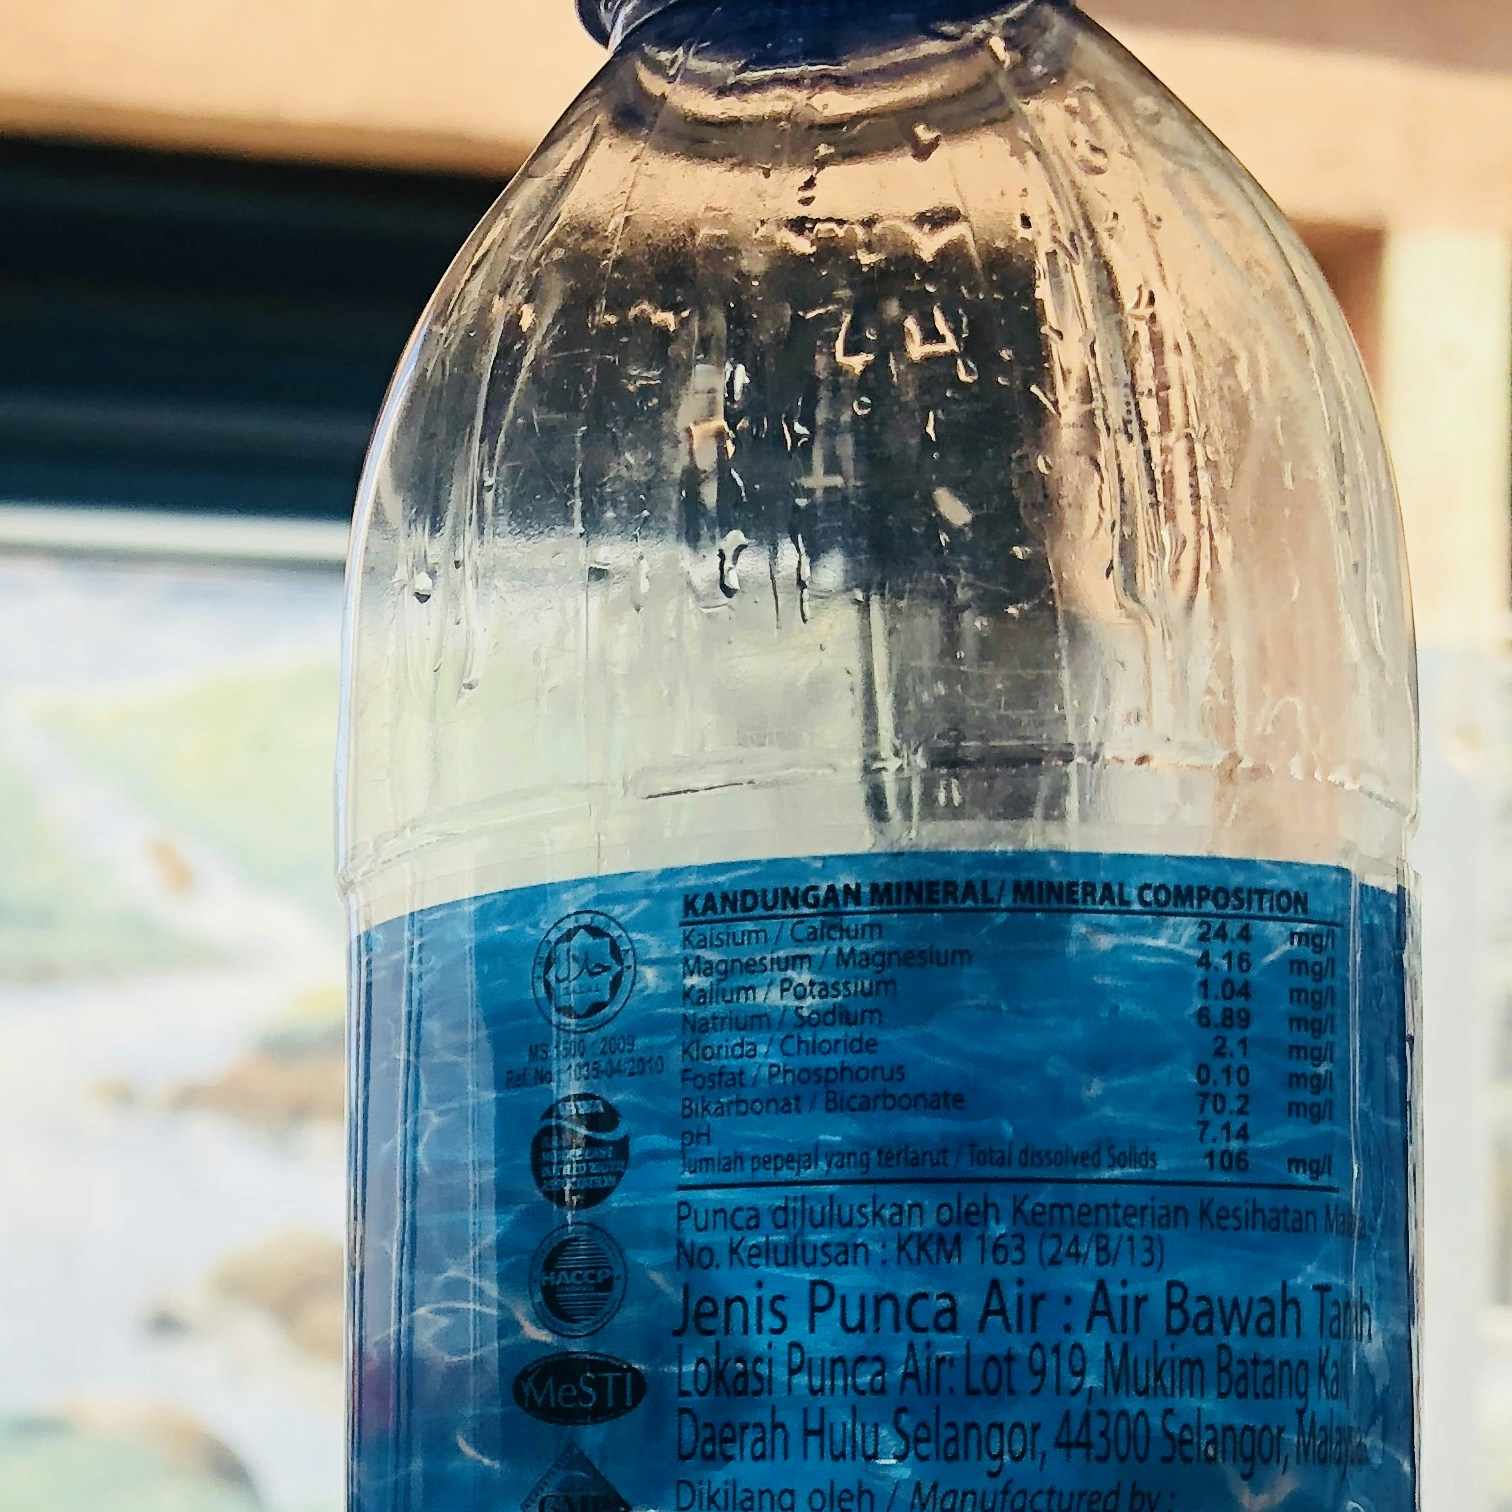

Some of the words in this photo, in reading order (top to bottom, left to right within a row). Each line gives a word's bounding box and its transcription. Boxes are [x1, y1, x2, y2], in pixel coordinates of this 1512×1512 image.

[683, 883, 862, 918] KANDUNGAN
[1011, 879, 1131, 908] MINERAL
[1137, 882, 1309, 916] COMPOSITION
[790, 919, 883, 943] Calcium
[1196, 920, 1251, 944] 24.4
[1289, 929, 1335, 954] mg/l
[682, 950, 812, 982] Magnesium
[836, 944, 973, 975] Magnesium
[1196, 950, 1252, 974] 4.16
[1289, 958, 1335, 983] mg/l
[681, 979, 756, 1007] Kalium
[779, 977, 898, 1002] Potassium
[1197, 979, 1252, 1002] 1.04
[1289, 986, 1335, 1012] mg/l
[681, 1010, 771, 1036] Natrium
[793, 1005, 883, 1029] Sodium
[1196, 1007, 1251, 1031] 6.89
[1289, 1014, 1335, 1040] mg/l
[680, 1037, 758, 1063] Klorida
[779, 1033, 879, 1058] Chloride
[1213, 1036, 1248, 1059] 2.1
[1288, 1042, 1334, 1068] mg/l
[680, 1067, 745, 1091] Fosfat
[768, 1061, 906, 1094] Phosphorus
[1196, 1063, 1250, 1087] 0.10
[1288, 1070, 1333, 1096] mg/l
[680, 1094, 802, 1120] Bikarbonat
[824, 1089, 965, 1114] Bicarbonate
[1195, 1093, 1250, 1116] 70.2
[1288, 1099, 1333, 1125] mg/l
[680, 1125, 711, 1148] pH
[1196, 1120, 1250, 1144] 7.14
[680, 1150, 744, 1177] Jumlah
[751, 1147, 820, 1178] pepejal
[823, 1151, 871, 1176] yang
[968, 1143, 1012, 1168] Total
[1018, 1143, 1101, 1169] dissolved
[1107, 1143, 1157, 1170] Solids
[1205, 1149, 1250, 1172] 106
[1287, 1154, 1332, 1180] mg/l
[676, 1200, 761, 1233] Punca
[936, 1192, 1000, 1228] oleh
[1013, 1194, 1189, 1231] Kementerian
[1199, 1197, 1317, 1234] Kesihatan
[676, 1238, 720, 1271] No.
[728, 1235, 869, 1269] Kelulusan
[898, 1232, 962, 1266] KKM
[977, 1232, 1027, 1266] 163
[1038, 1231, 1164, 1272] (24/B/13)
[671, 1279, 788, 1337] Jenis
[808, 1278, 958, 1335] Punca
[978, 1277, 1047, 1335] Air
[1085, 1278, 1148, 1336] Air
[1166, 1279, 1303, 1340] Bawah
[678, 1340, 773, 1398] Lokasi
[788, 1340, 886, 1397] Punca
[966, 1340, 1016, 1397] Lot
[1104, 1339, 1205, 1399] Mukim
[1217, 1343, 1309, 1412] Batang
[678, 1405, 788, 1462] Daerah
[803, 1405, 879, 1463] Hulu
[892, 1405, 1045, 1479] Selangor,
[1054, 1408, 1150, 1464] 44300
[1160, 1407, 1288, 1481] Selangor,
[808, 1479, 875, 1512] oleh
